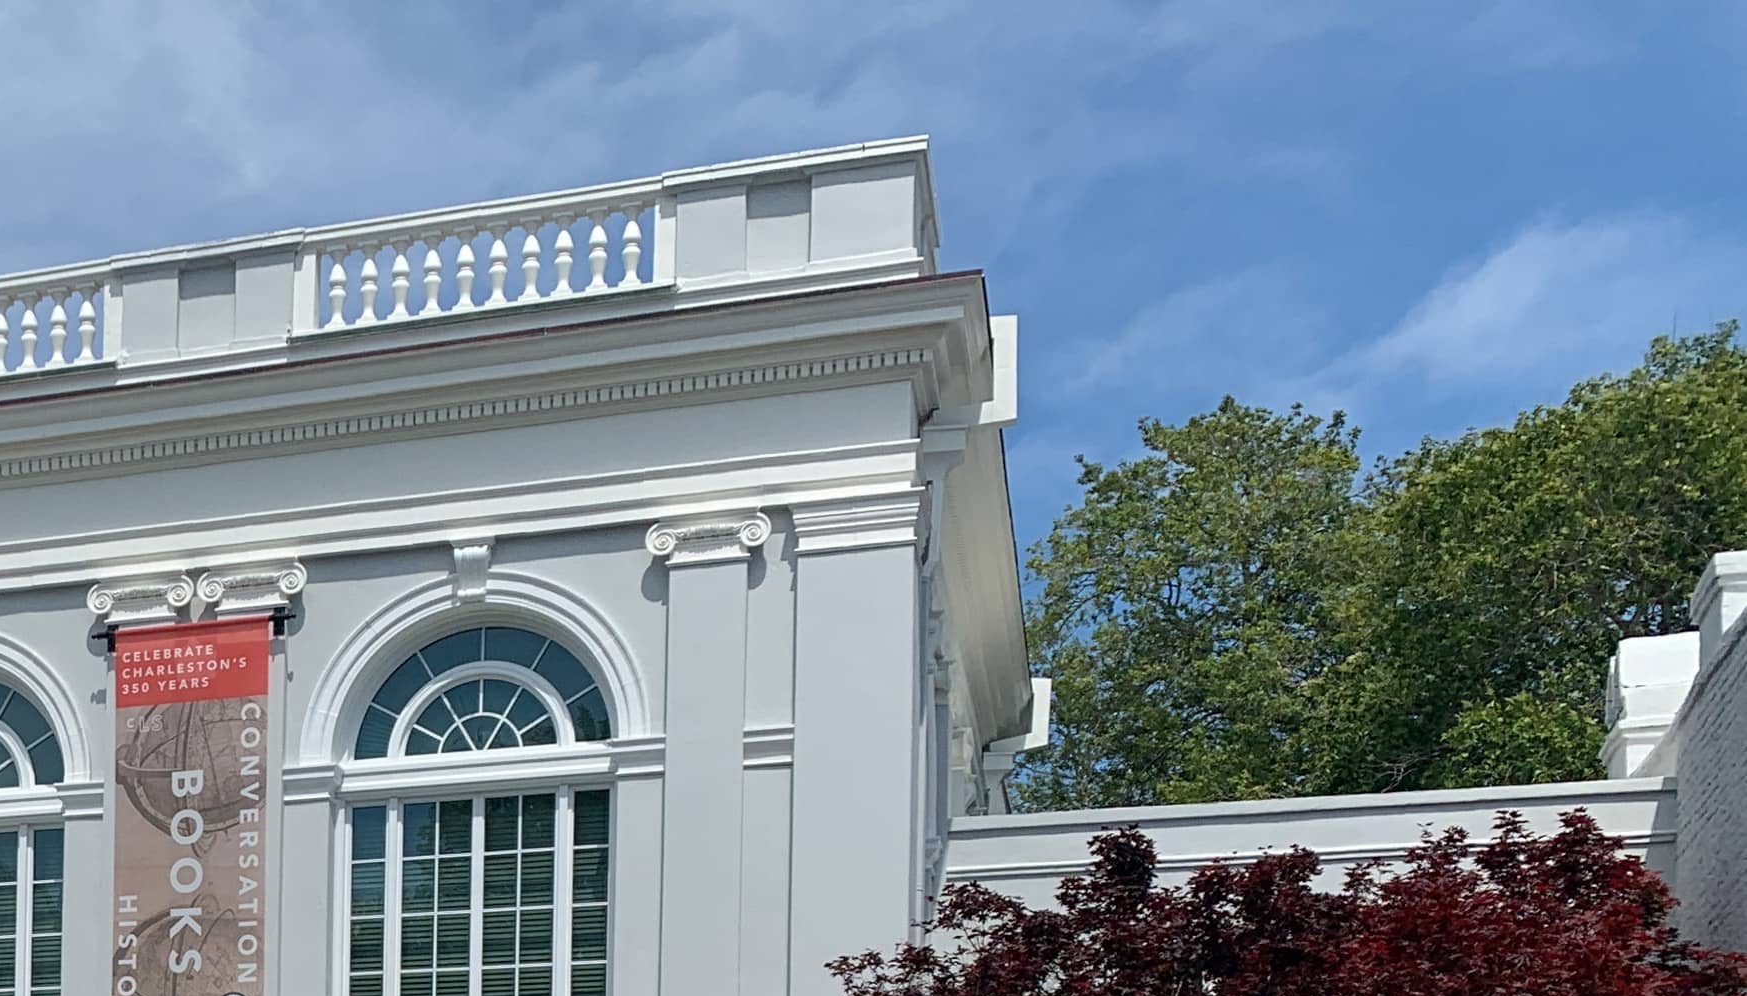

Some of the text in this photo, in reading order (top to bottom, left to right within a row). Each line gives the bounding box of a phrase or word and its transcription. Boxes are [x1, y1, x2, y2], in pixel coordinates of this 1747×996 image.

[122, 644, 214, 663] CELEBRATE
[122, 657, 247, 679] CHARLESTON'S
[121, 676, 210, 695] 350 YEARS
[237, 703, 261, 983] CONVERSATION
[169, 769, 203, 974] BOOKS
